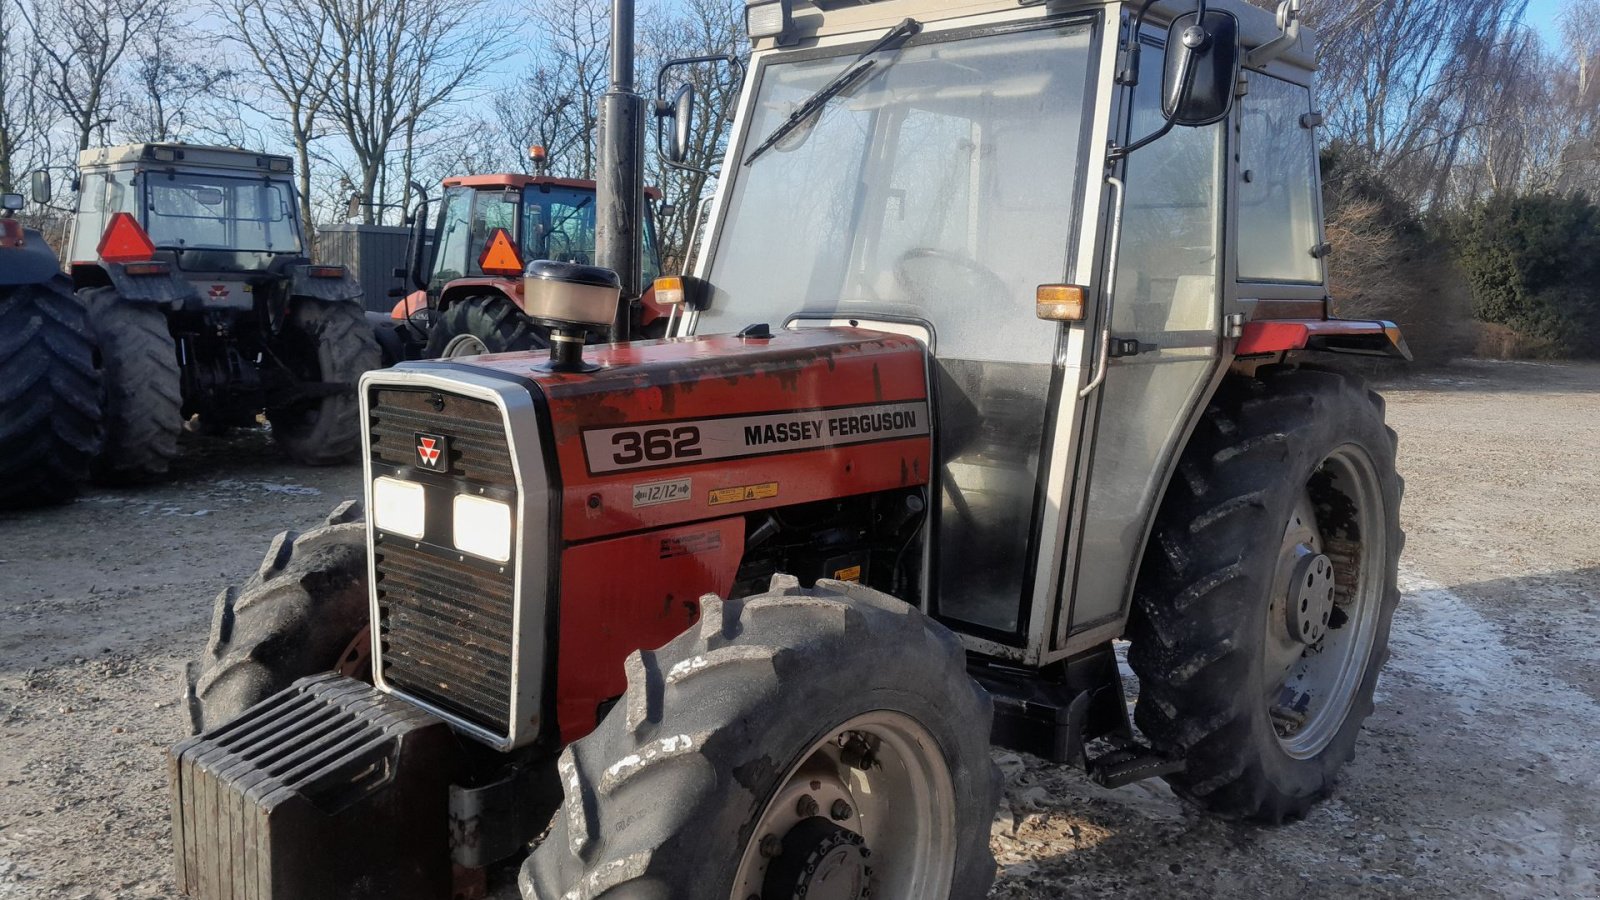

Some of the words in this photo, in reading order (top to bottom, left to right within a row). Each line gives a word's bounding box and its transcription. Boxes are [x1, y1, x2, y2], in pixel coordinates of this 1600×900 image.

[612, 426, 702, 465] 362
[744, 421, 823, 446] MASSEY
[828, 410, 916, 437] FERGUSON
[647, 483, 677, 501] 12/12
